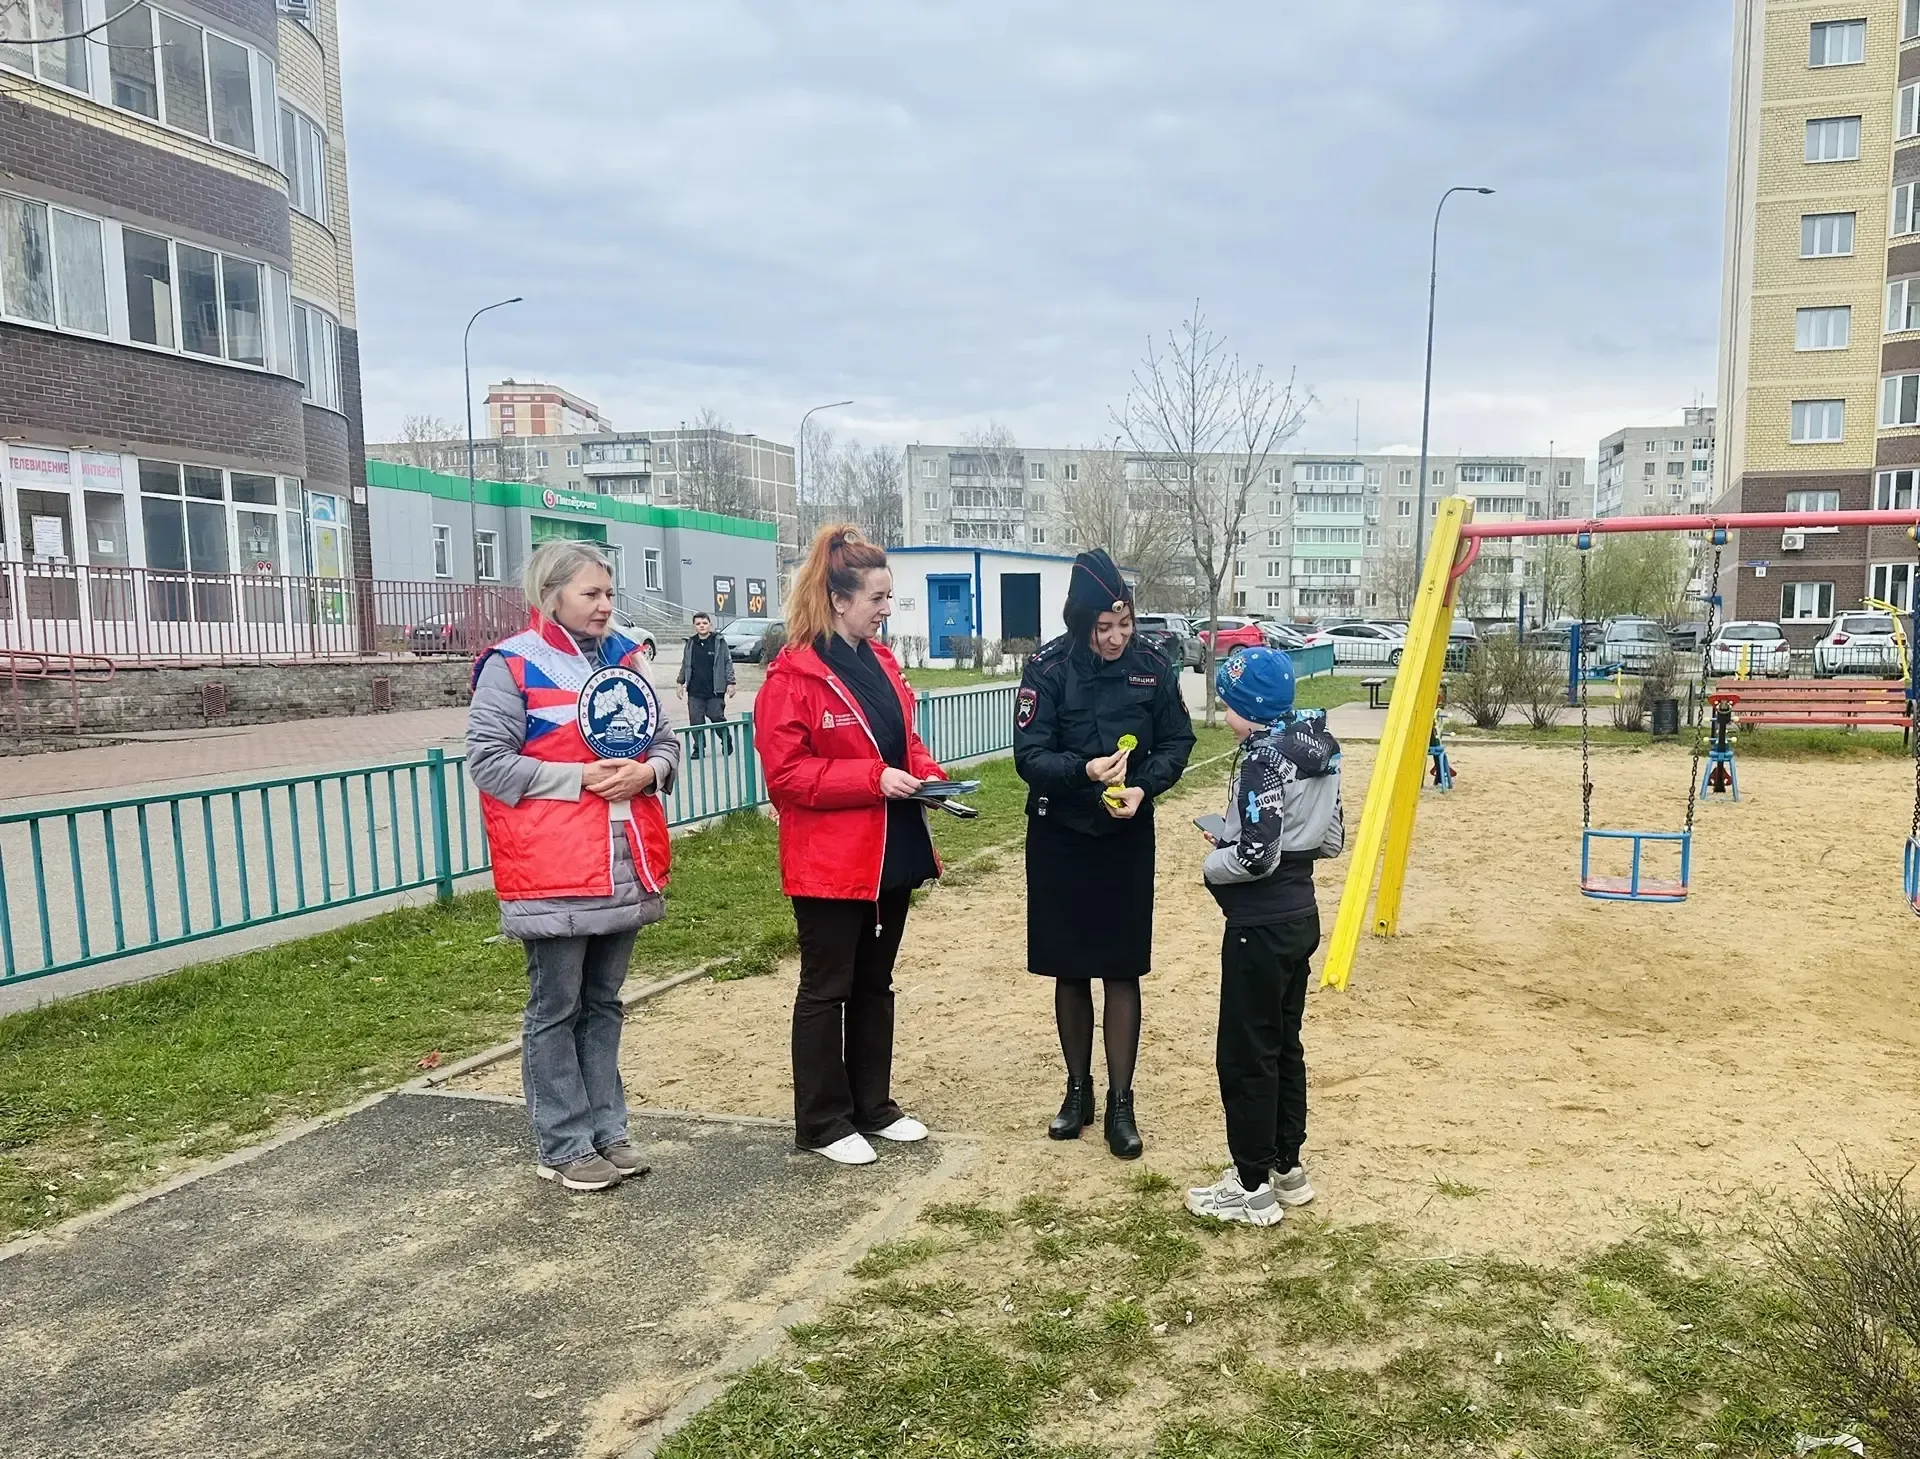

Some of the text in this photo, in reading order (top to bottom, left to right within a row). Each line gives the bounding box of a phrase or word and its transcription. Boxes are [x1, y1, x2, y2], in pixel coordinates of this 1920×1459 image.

[9, 457, 69, 474] ТЕЛЕВИДЕНИЕ
[82, 463, 121, 478] ИНТЕРНЕТ
[749, 595, 762, 612] 49
[1128, 675, 1155, 684] ОЛИЦИЯ
[582, 670, 655, 728] ГОСАВТОИНСПЕКЦИЯ
[1119, 739, 1136, 748] STOP
